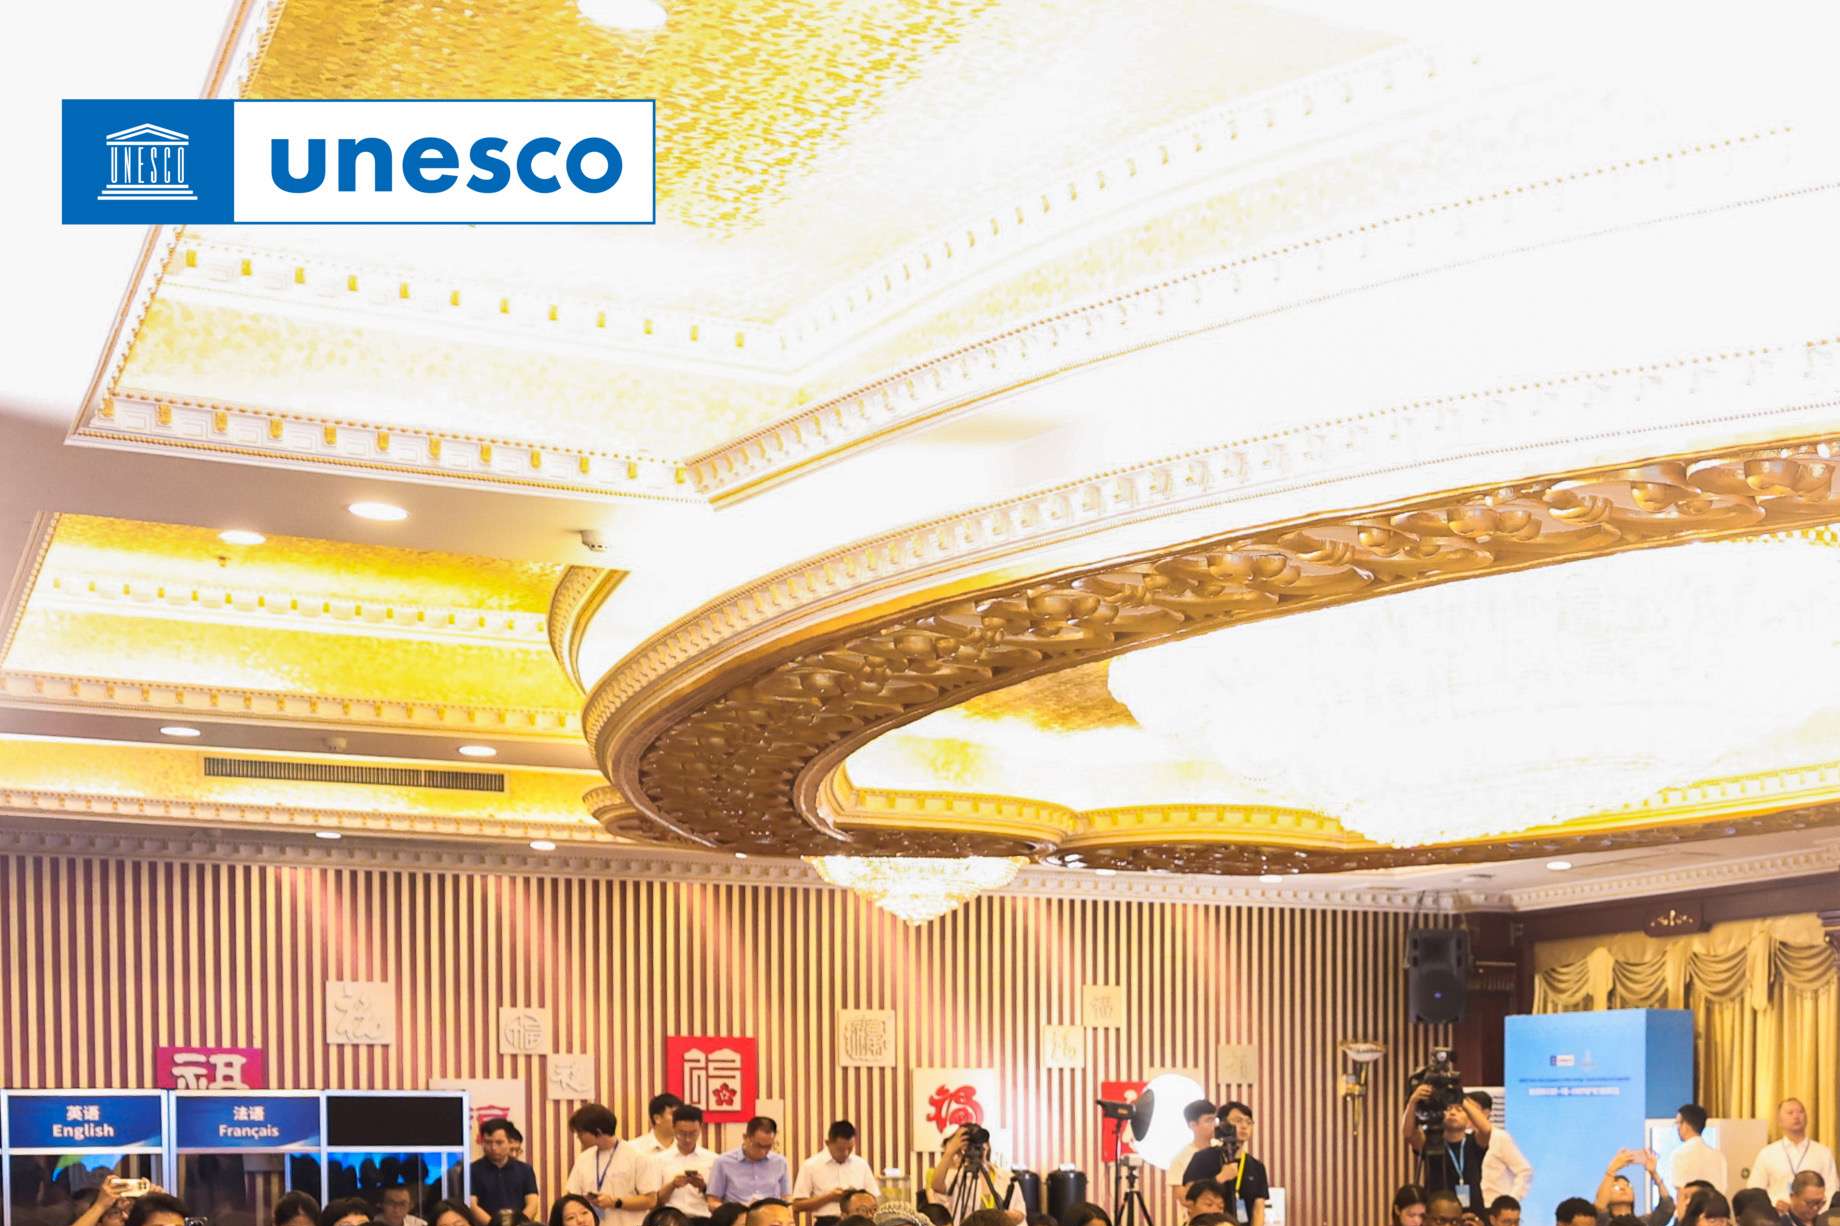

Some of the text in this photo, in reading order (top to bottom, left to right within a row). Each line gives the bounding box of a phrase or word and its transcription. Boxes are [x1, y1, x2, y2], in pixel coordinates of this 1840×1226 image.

[66, 1105, 100, 1121] 英语
[233, 1105, 265, 1121] 法语
[52, 1123, 114, 1140] English
[218, 1123, 280, 1140] Français
